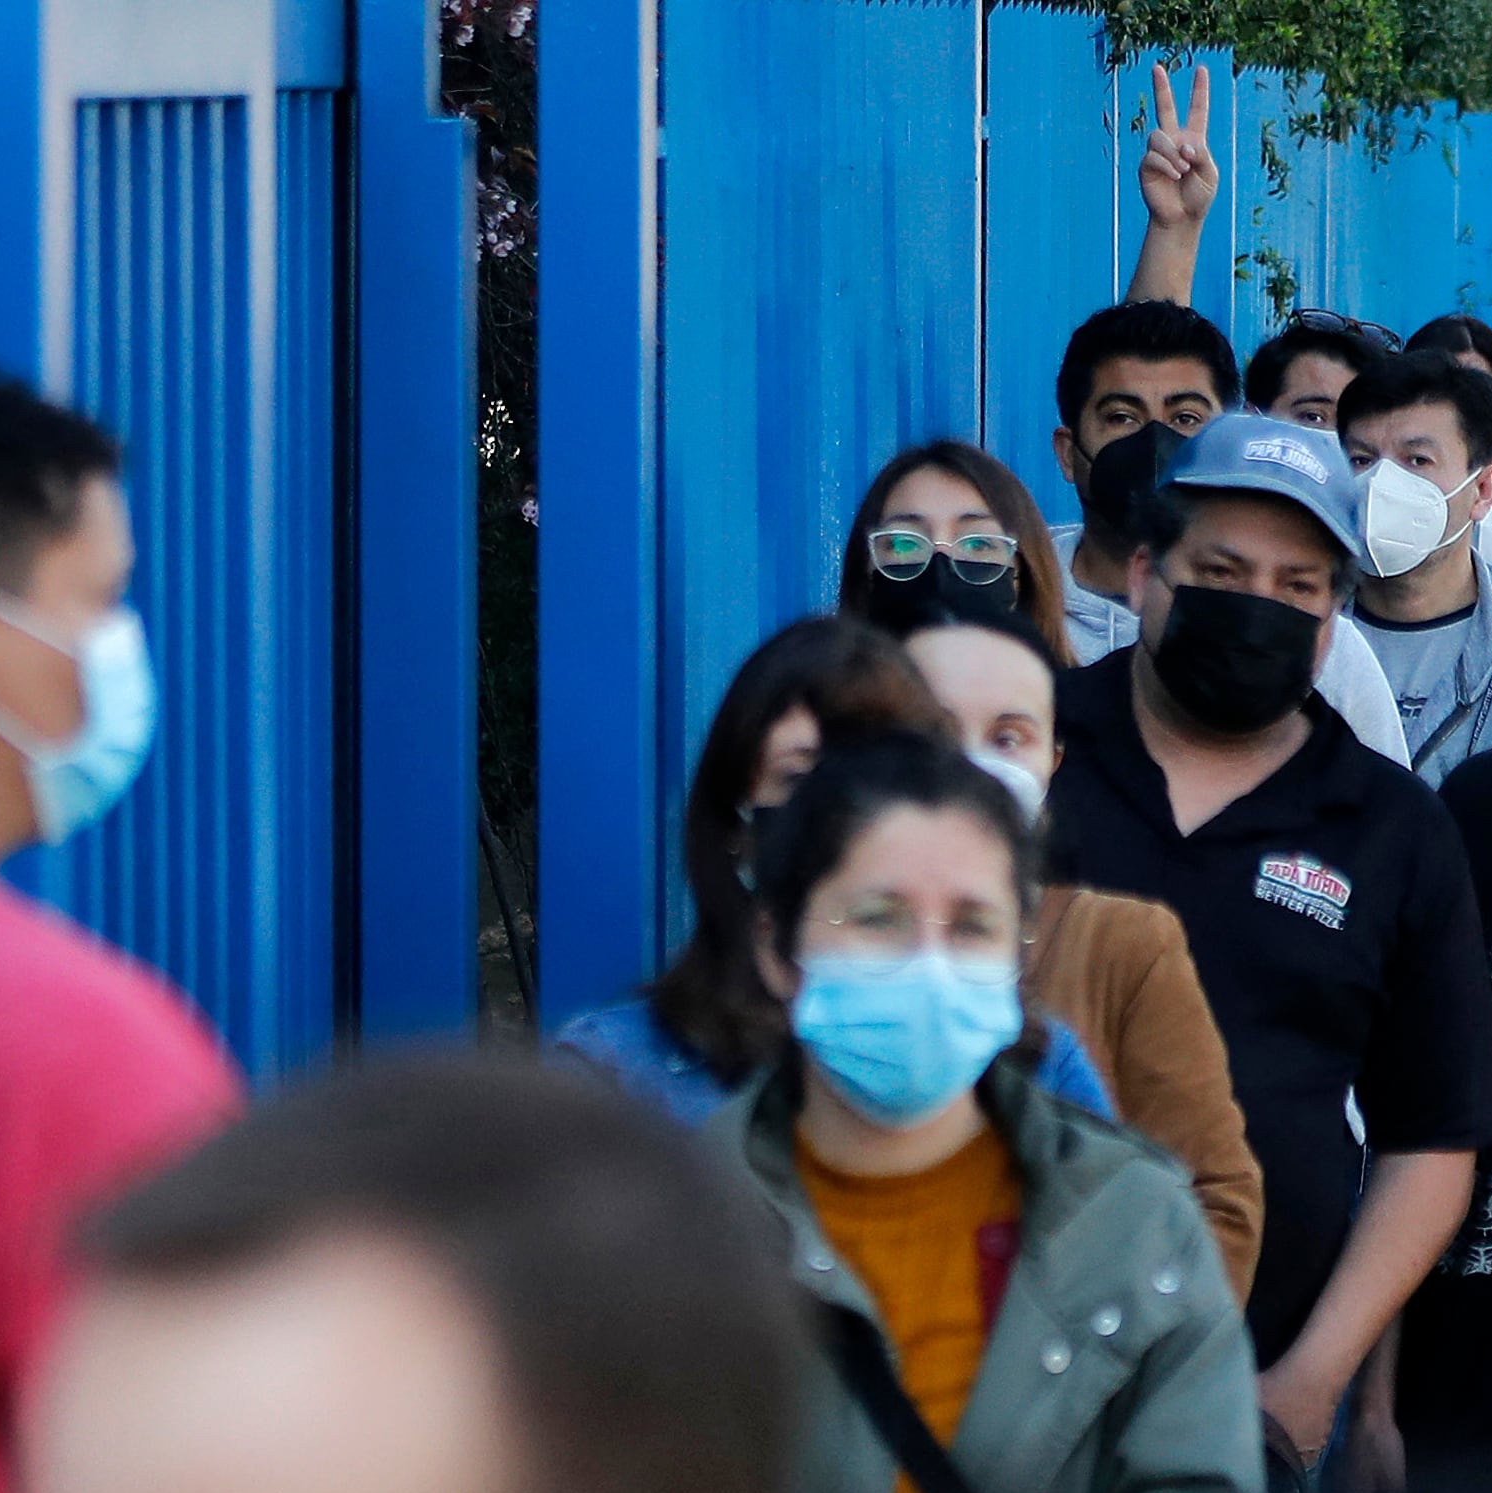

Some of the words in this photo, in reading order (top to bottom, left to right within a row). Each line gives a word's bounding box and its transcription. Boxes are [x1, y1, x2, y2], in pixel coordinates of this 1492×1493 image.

[1250, 444, 1282, 461] PAPA
[1263, 862, 1298, 884] PAPA
[1255, 888, 1305, 914] BETTER
